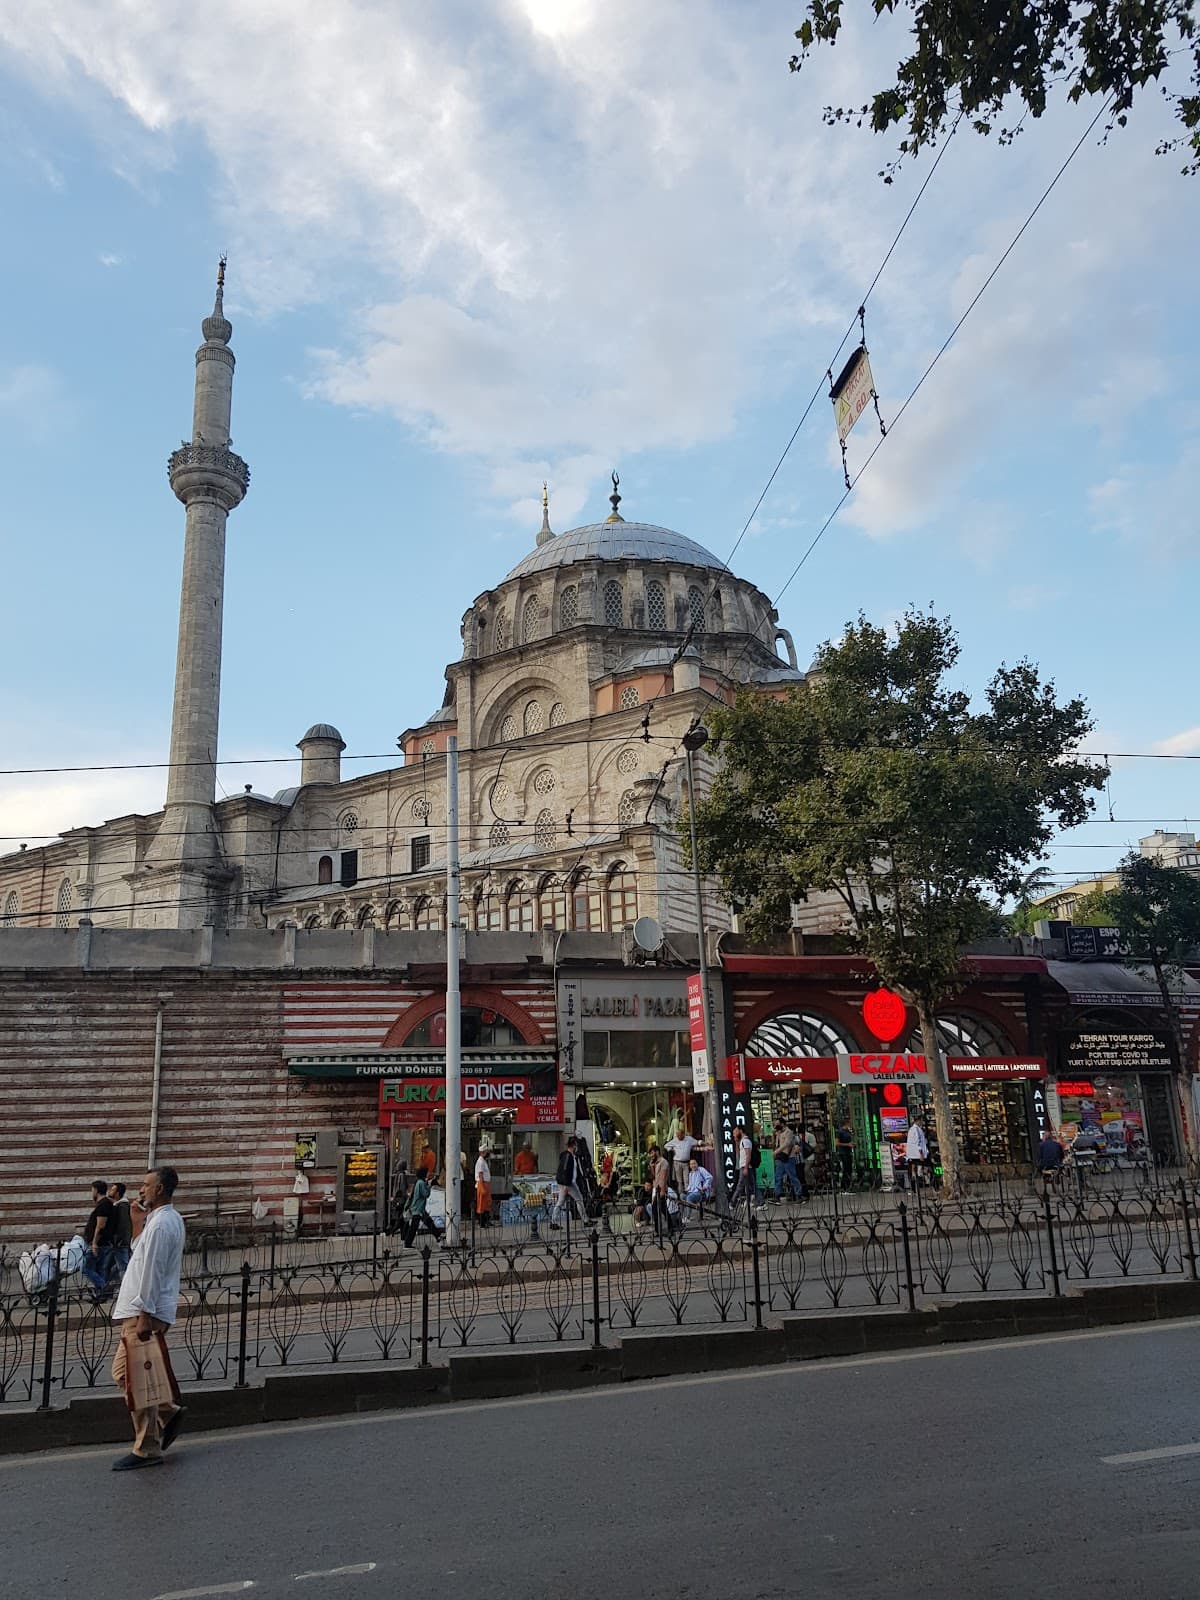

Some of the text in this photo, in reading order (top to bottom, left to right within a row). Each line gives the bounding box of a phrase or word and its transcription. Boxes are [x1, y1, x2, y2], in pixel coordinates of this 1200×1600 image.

[582, 993, 639, 1017] LALELİ
[1079, 1034, 1154, 1042] TEHRAN TOUR KARGO
[356, 1064, 443, 1074] FURKAN DÖNER
[851, 1055, 928, 1074] ECZAN
[383, 1079, 525, 1103] FURKA DÖNER
[722, 1093, 734, 1192] PHARMACY
